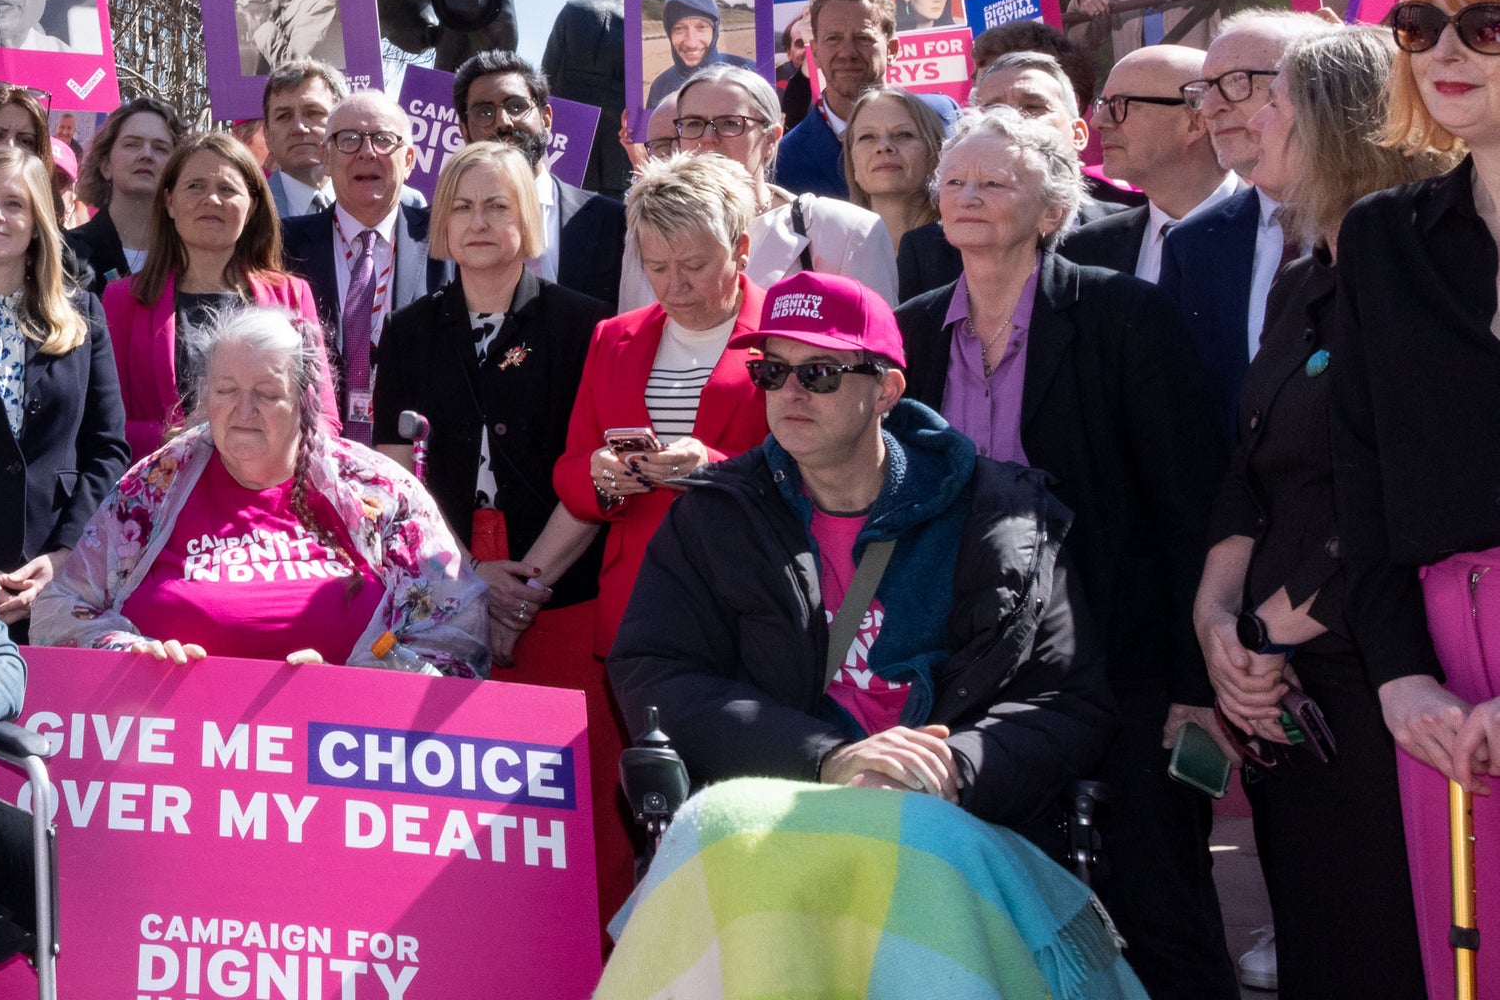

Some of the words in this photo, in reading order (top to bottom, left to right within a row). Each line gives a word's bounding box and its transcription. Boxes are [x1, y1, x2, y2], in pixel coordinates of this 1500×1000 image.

[985, 18, 998, 30] IN
[923, 39, 963, 56] FOR
[355, 75, 371, 83] FOR
[773, 299, 821, 311] DIGNITY
[770, 310, 781, 320] IN
[23, 711, 175, 765] GIVE
[201, 721, 293, 773] ME
[318, 730, 565, 800] CHOICE
[219, 789, 319, 843] MY
[345, 799, 567, 869] DEATH
[140, 914, 331, 954] CAMPAIGN
[347, 930, 419, 963] FOR
[137, 943, 419, 1000] DIGNITY
